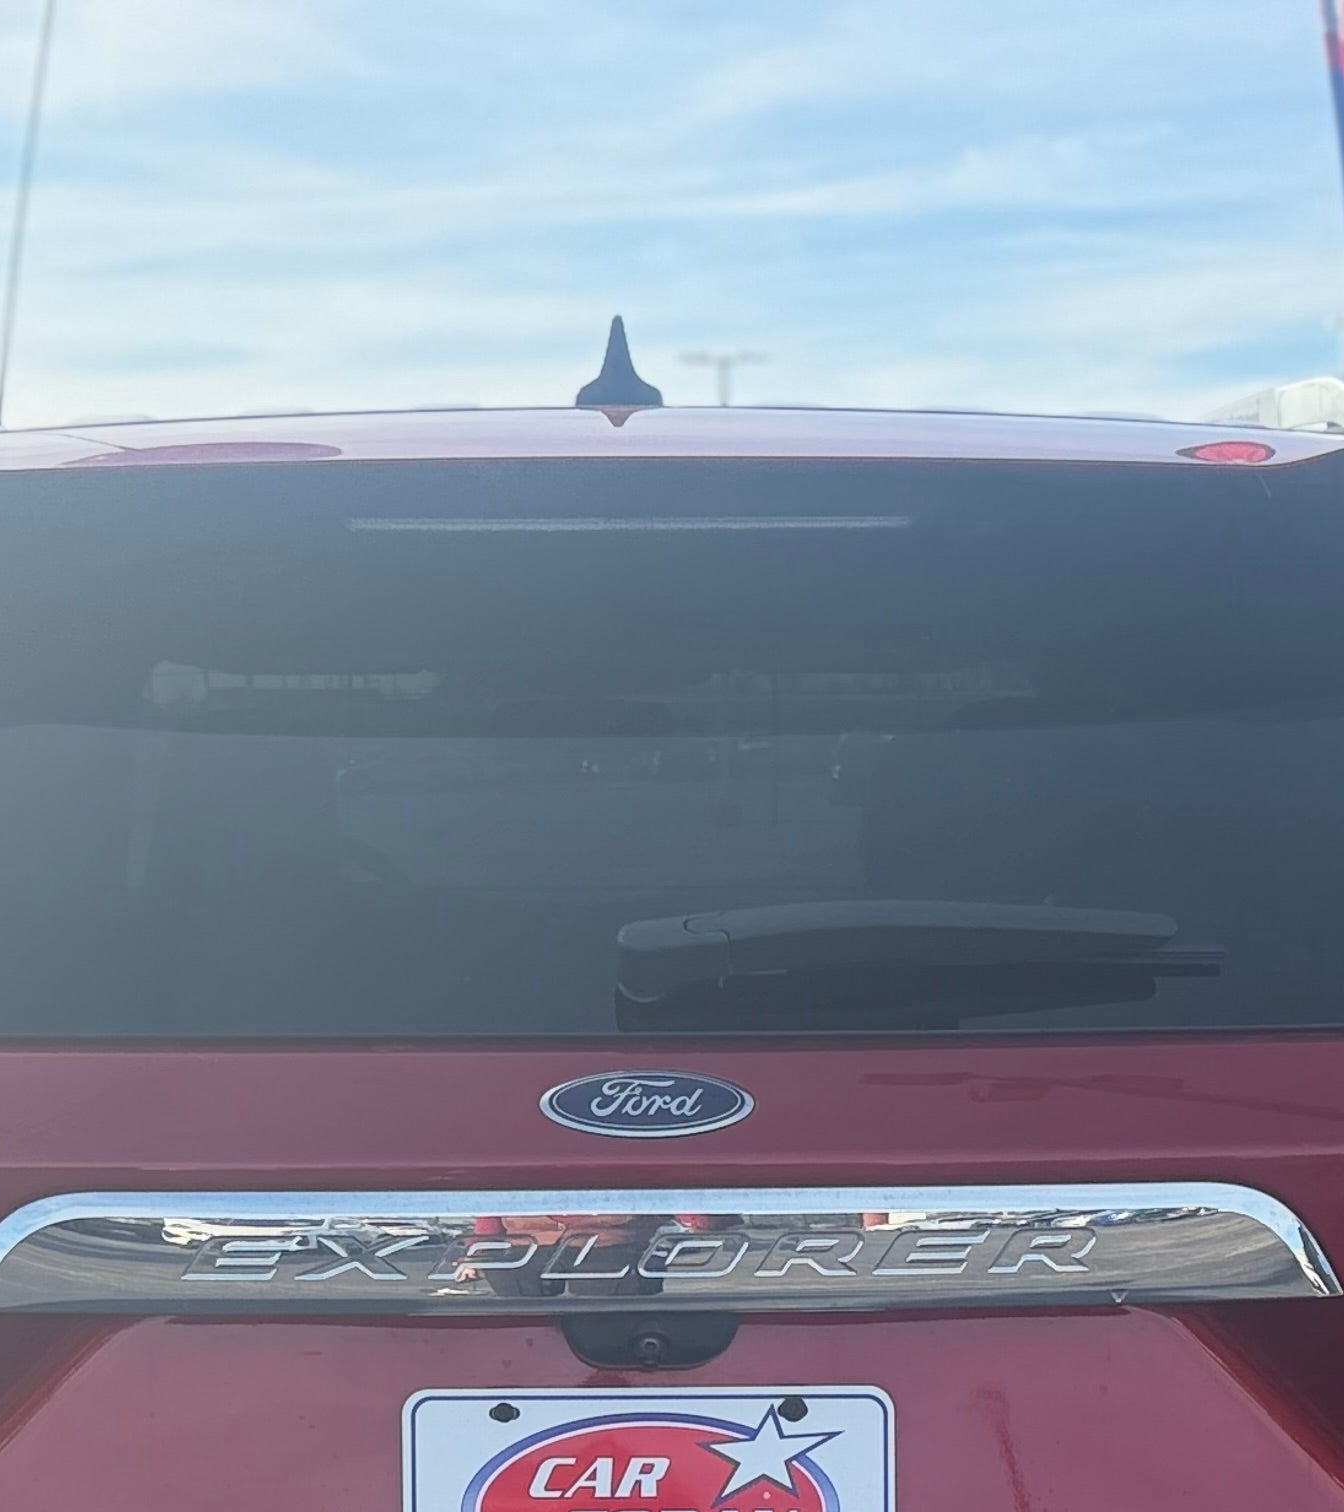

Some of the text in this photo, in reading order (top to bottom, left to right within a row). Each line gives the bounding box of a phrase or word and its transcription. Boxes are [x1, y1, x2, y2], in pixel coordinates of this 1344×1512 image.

[589, 1078, 704, 1117] Ford
[179, 1226, 1097, 1282] EXPLORER
[528, 1456, 671, 1499] CAR
